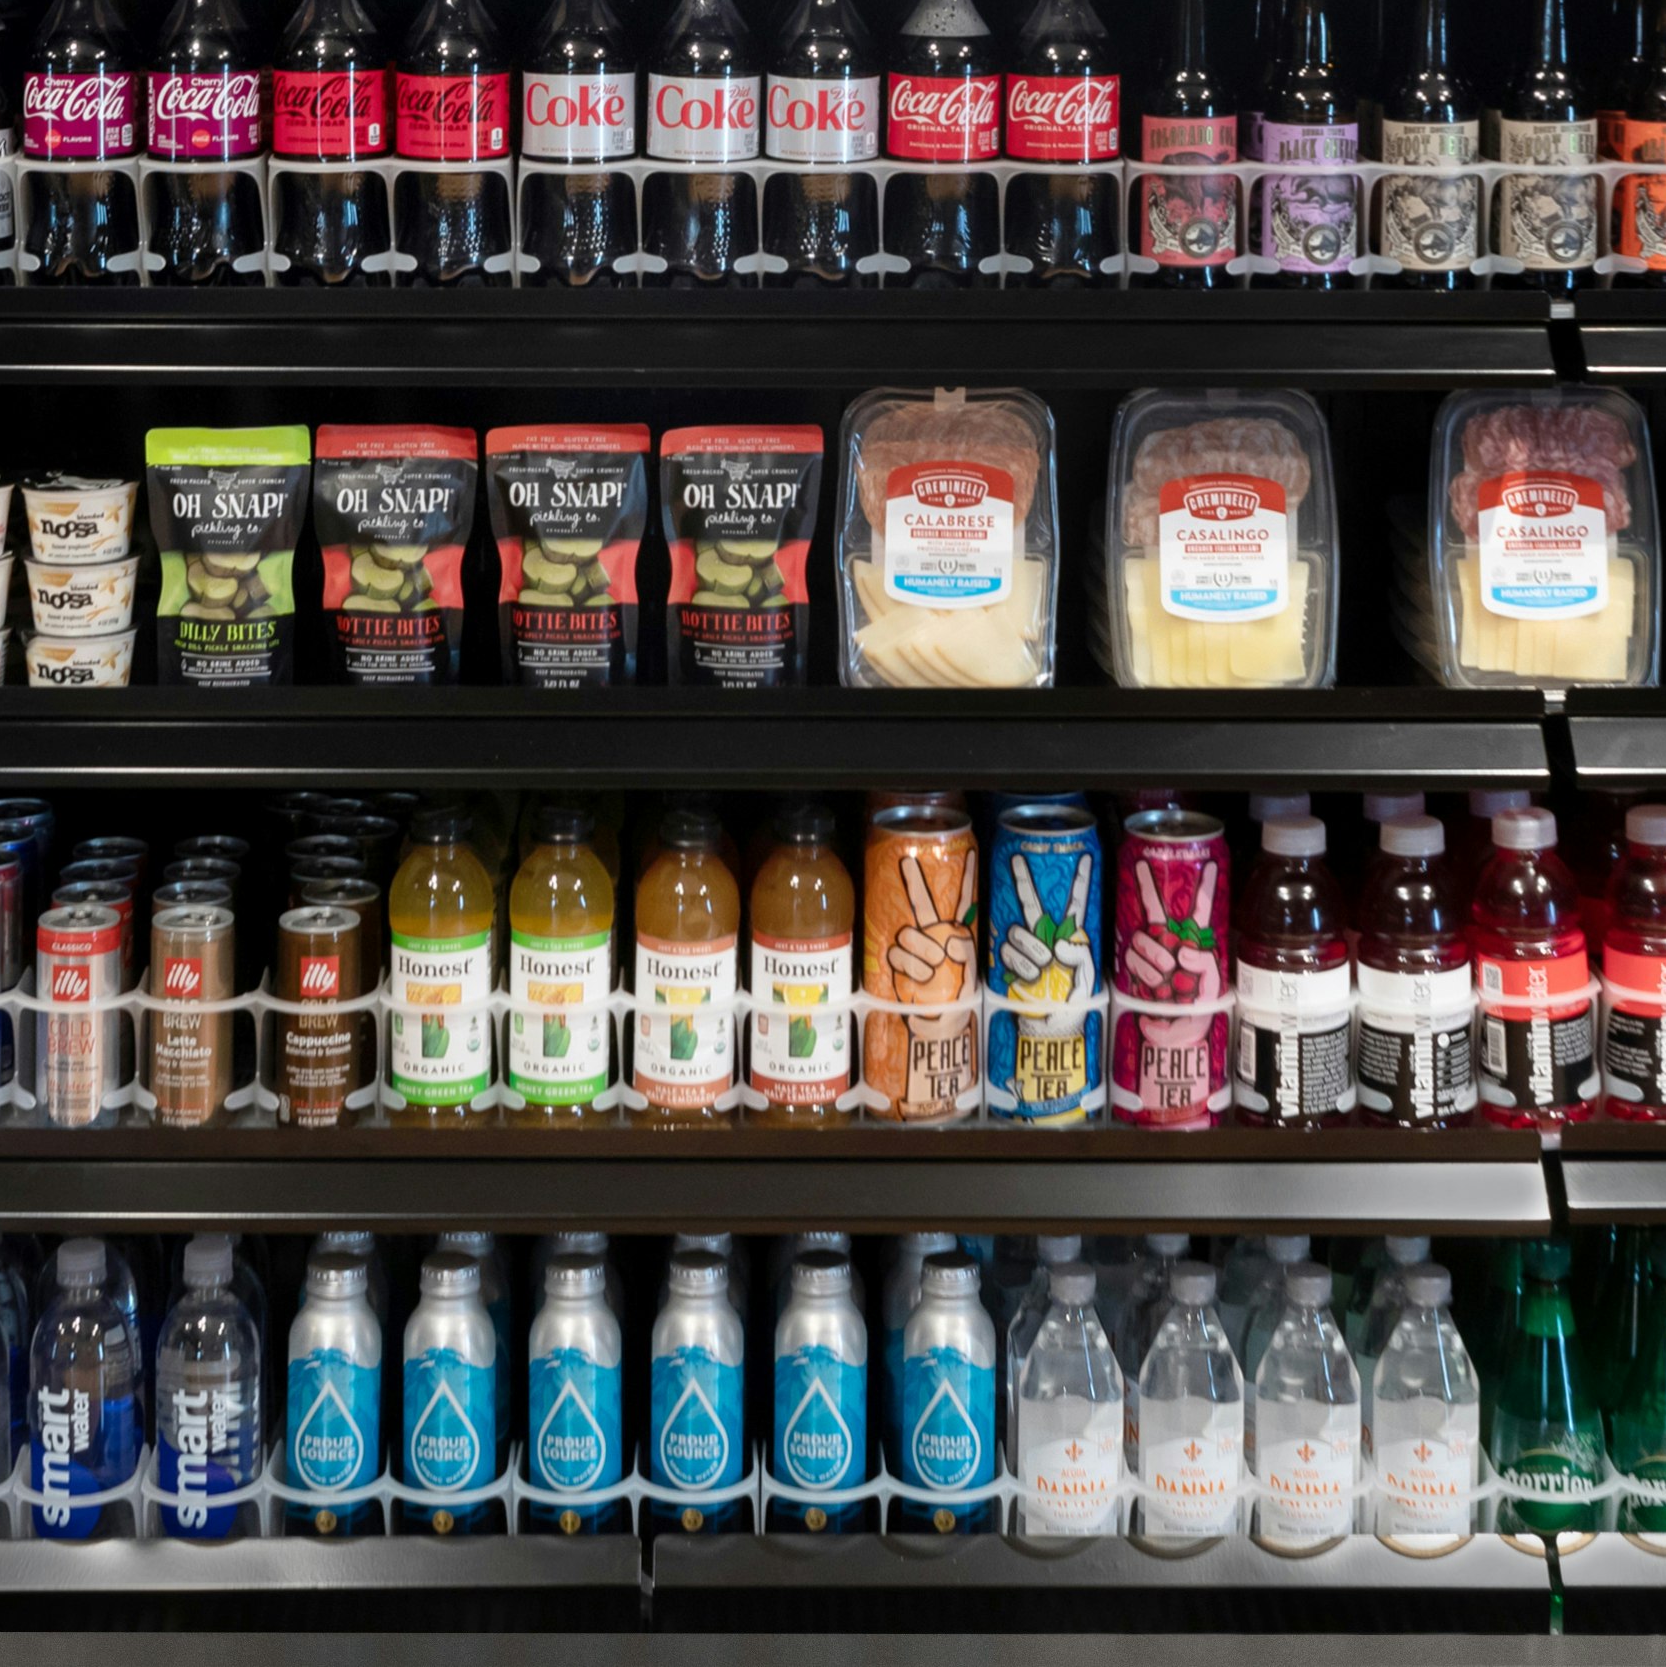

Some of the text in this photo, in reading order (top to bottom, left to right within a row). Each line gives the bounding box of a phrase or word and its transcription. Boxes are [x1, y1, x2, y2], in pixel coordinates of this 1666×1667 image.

[44, 77, 75, 89] Cherry
[191, 77, 223, 89] Cherry
[24, 75, 130, 122] Coca-Cola
[158, 74, 261, 121] Coca-Cola
[526, 82, 626, 129] Coke
[656, 84, 757, 132] Coke
[768, 84, 867, 132] Coke
[891, 80, 997, 125] Coca-Cola
[1008, 80, 1113, 126] Coca-Cola
[906, 124, 942, 132] ORIGINAL
[508, 481, 627, 510] OH SNAP!
[682, 481, 801, 510] OH SNAP!
[918, 477, 990, 499] CREMINELLI
[1187, 488, 1257, 509] CREMINELLI
[1505, 487, 1575, 508] CREMINELLI
[171, 491, 288, 520] OH SNAP!
[336, 487, 454, 515] OH SNAP!
[40, 518, 100, 541] noosa
[191, 521, 263, 540] pickling co.
[704, 512, 757, 530] pickling
[903, 513, 995, 529] CALABRESE
[1176, 527, 1270, 543] CASALINGO
[1495, 525, 1589, 540] CASALINGO
[903, 576, 991, 590] HUMANELY RAISED
[179, 619, 277, 643] DILLY BITES
[681, 611, 792, 632] HOTTIE BITES
[51, 942, 93, 953] CLASSICO
[301, 961, 339, 992] illy
[398, 956, 471, 977] Honest
[519, 955, 593, 977] Honest
[645, 958, 720, 981] Honest
[762, 957, 837, 980] Honest
[52, 969, 88, 1002] illy
[164, 963, 201, 993] illy
[162, 1014, 202, 1030] BREW
[298, 1013, 340, 1030] BREW
[48, 1037, 97, 1057] BREW
[166, 1035, 198, 1048] Latte
[286, 1033, 353, 1050] Cappuccino
[155, 1045, 213, 1060] Macchiato
[912, 1038, 972, 1073] PEACE
[1020, 1038, 1084, 1073] PEACE
[1143, 1043, 1206, 1079] PEACE
[404, 1063, 466, 1075] ORGANIC
[524, 1062, 587, 1075] ORGANIC
[650, 1062, 712, 1075] ORGANIC
[398, 1085, 425, 1097] HONEY
[73, 1388, 90, 1453] water
[303, 1434, 354, 1448] PROUD
[419, 1434, 470, 1448] PROUD
[546, 1434, 597, 1448] PROUD
[668, 1433, 719, 1446] PROUD
[37, 1386, 70, 1528] smart
[173, 1388, 208, 1529] smart
[301, 1448, 356, 1463] SOURCE
[416, 1448, 471, 1463] SOURCE
[542, 1448, 598, 1463] SOURCE
